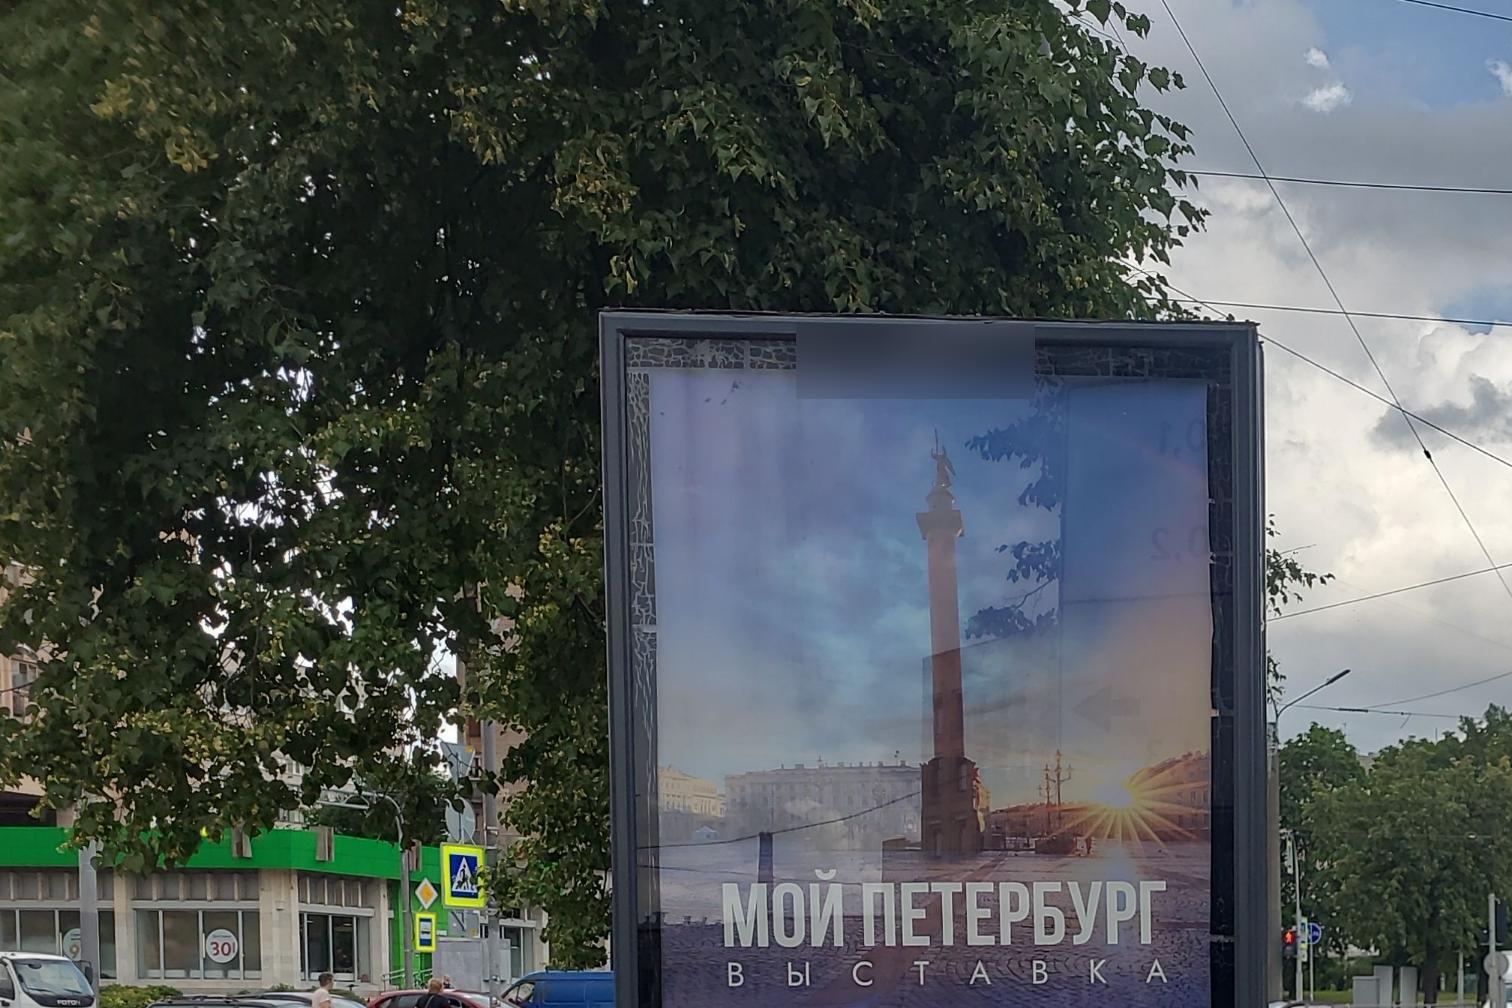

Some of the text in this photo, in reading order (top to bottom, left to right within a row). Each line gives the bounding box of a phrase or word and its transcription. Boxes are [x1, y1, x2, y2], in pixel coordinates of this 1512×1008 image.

[721, 868, 1167, 948] МОЙ ПЕТЕРБУРГ
[727, 958, 1168, 987] ВЫСТАВКА
